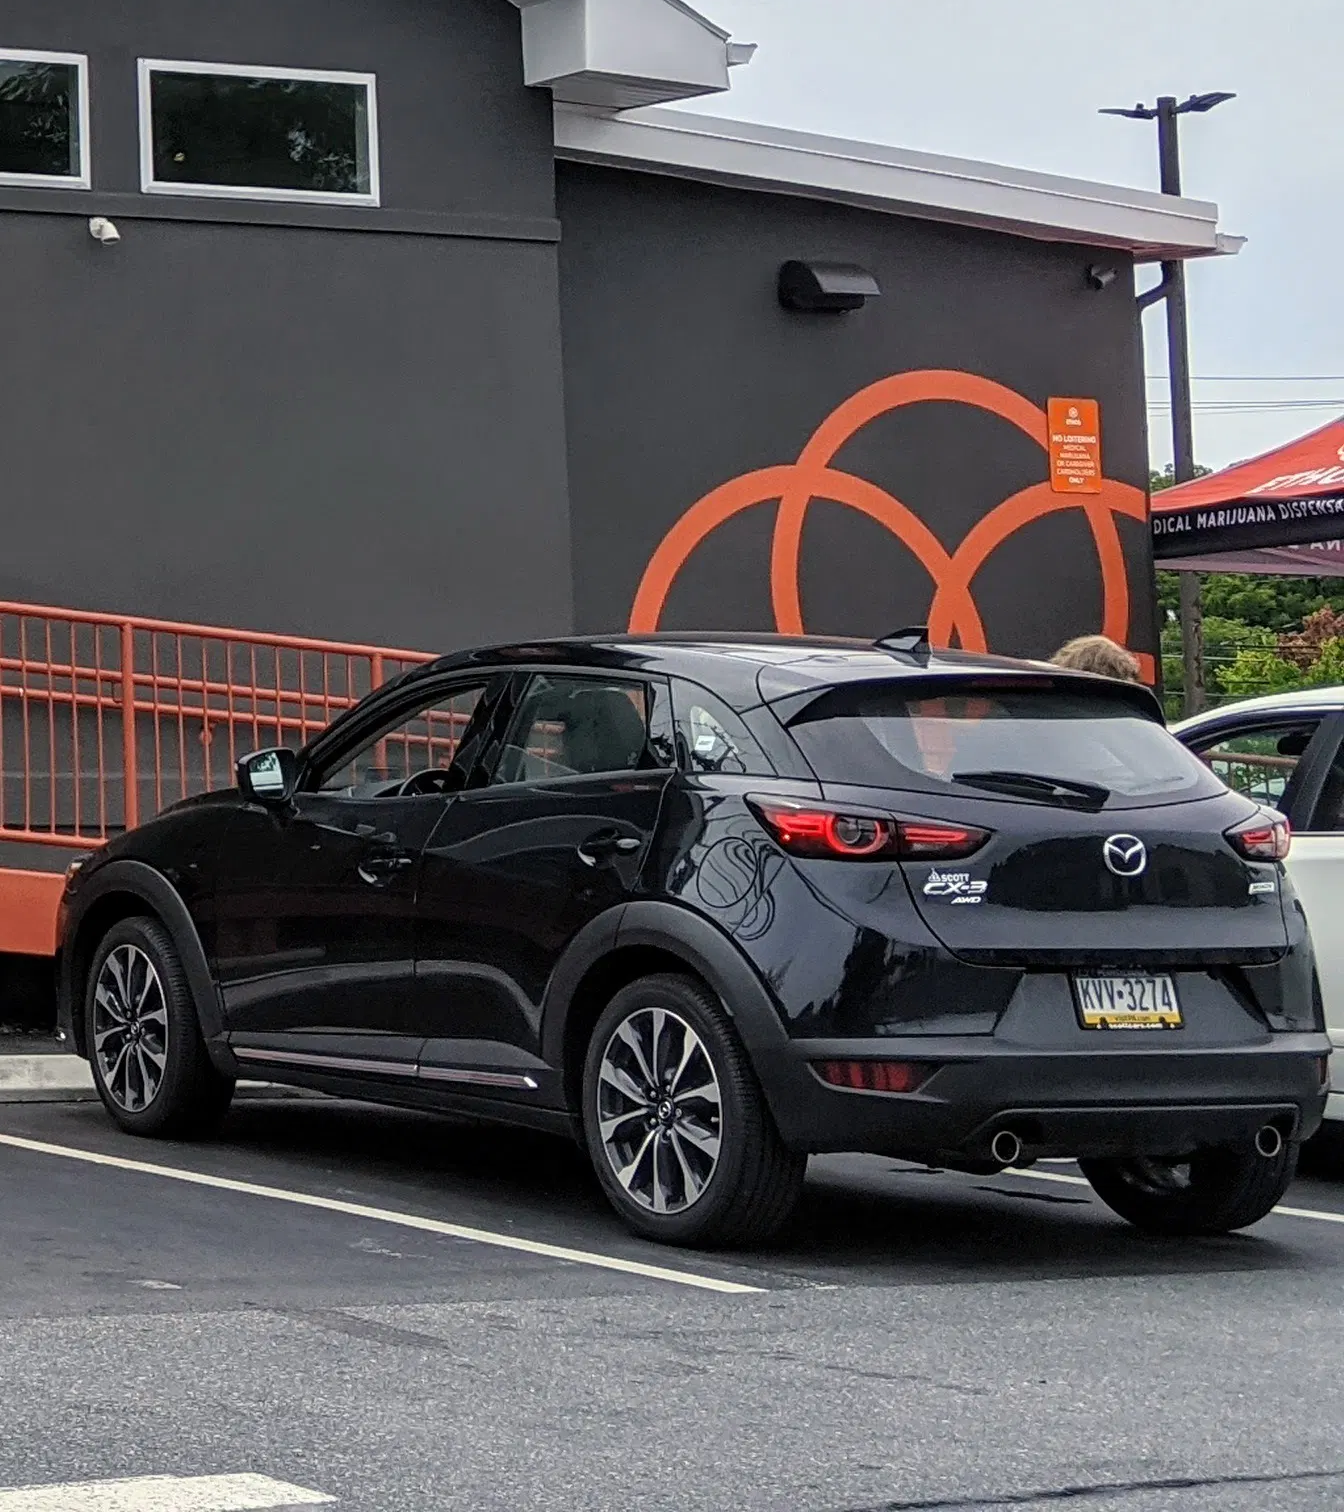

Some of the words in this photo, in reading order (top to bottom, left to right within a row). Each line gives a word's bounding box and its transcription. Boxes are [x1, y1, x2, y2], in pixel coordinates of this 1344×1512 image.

[1052, 434, 1063, 442] NO
[1153, 517, 1192, 535] DICAL
[1197, 505, 1276, 529] MARIJUANA
[1279, 498, 1344, 519] DISPENSA
[941, 873, 970, 882] SCOTT
[923, 881, 988, 895] CX-3
[951, 896, 982, 904] AWD
